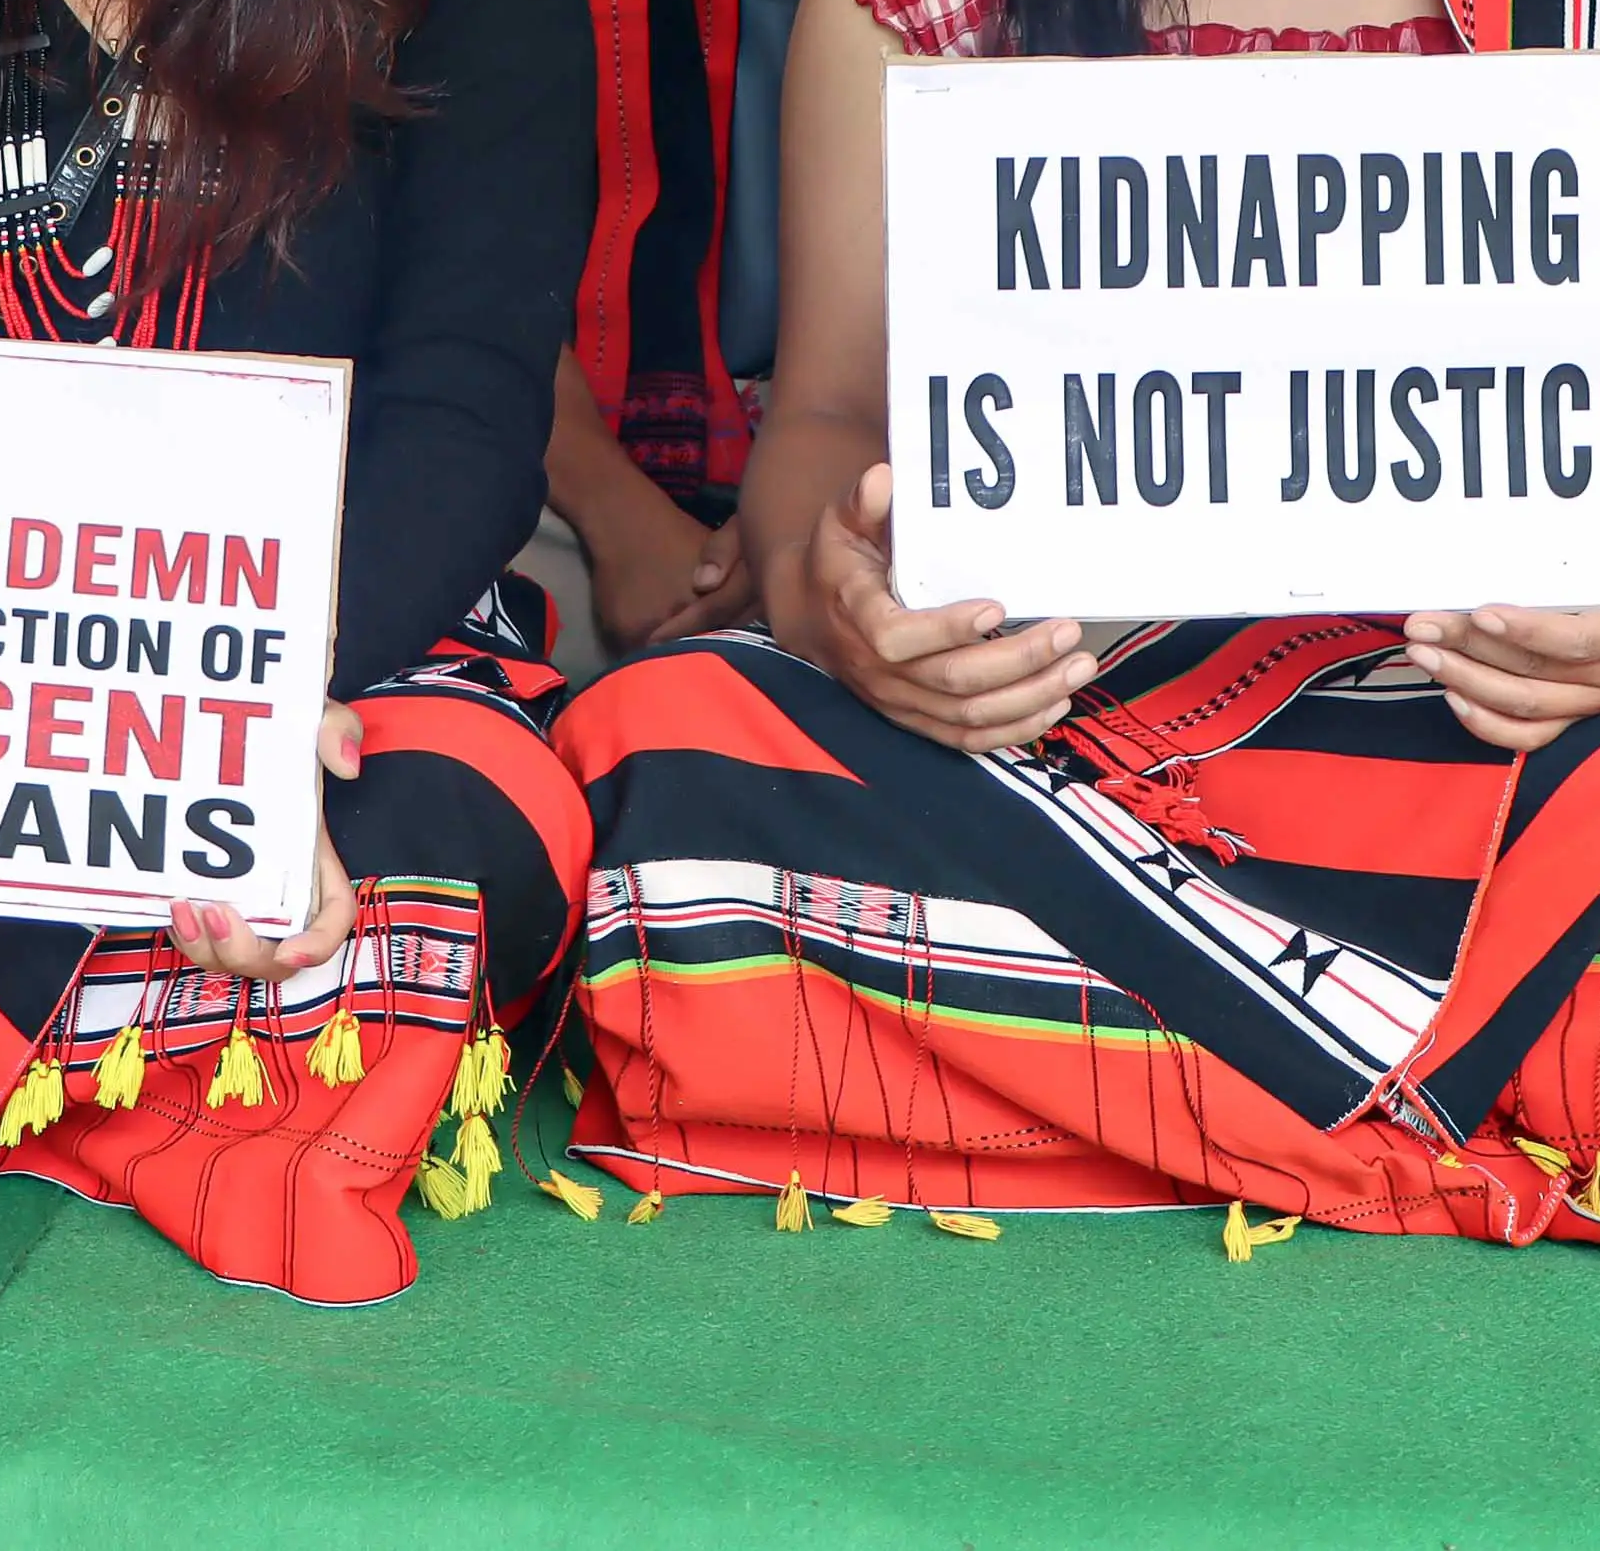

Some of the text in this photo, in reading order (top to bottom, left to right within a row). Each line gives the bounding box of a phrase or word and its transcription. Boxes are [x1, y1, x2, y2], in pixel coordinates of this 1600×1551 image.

[996, 148, 1580, 291] KIDNAPPING
[928, 373, 1016, 510] IS
[1063, 370, 1242, 507] NOT
[200, 625, 286, 684] OF
